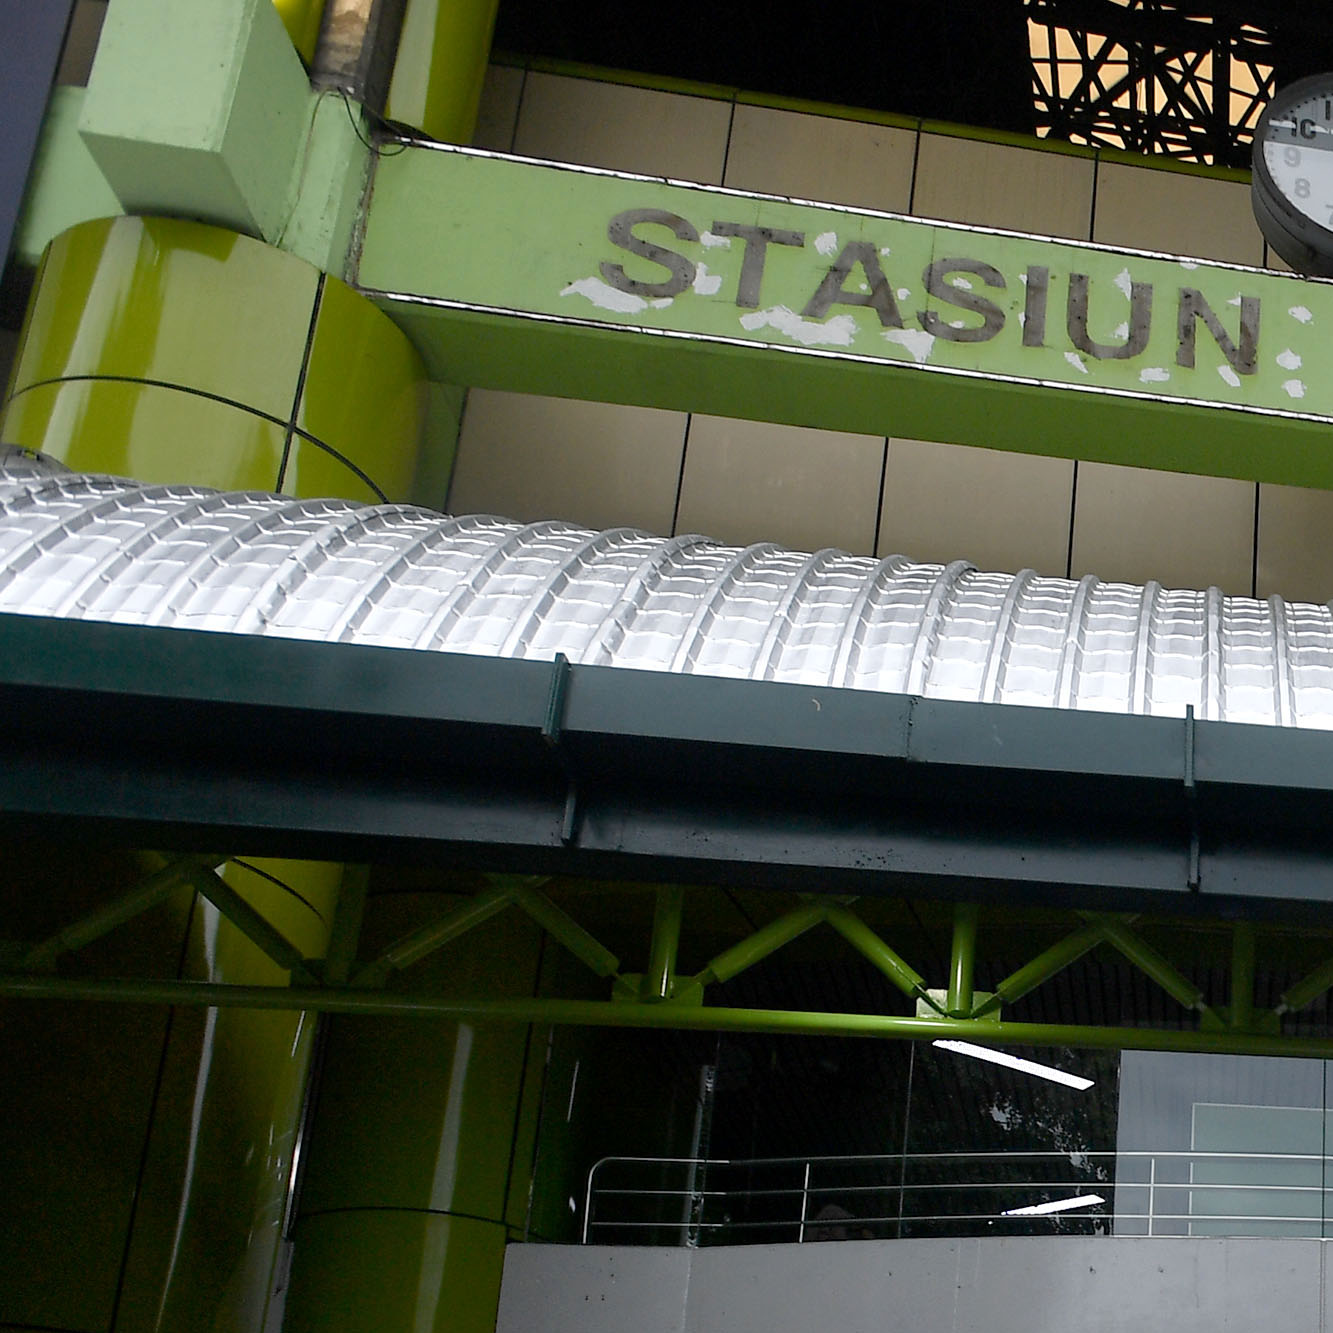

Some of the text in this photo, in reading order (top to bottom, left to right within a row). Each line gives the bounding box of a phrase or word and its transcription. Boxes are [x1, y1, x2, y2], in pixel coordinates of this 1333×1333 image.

[1284, 147, 1301, 167] 9
[1295, 178, 1311, 199] 8
[600, 208, 1261, 375] STASIUN
